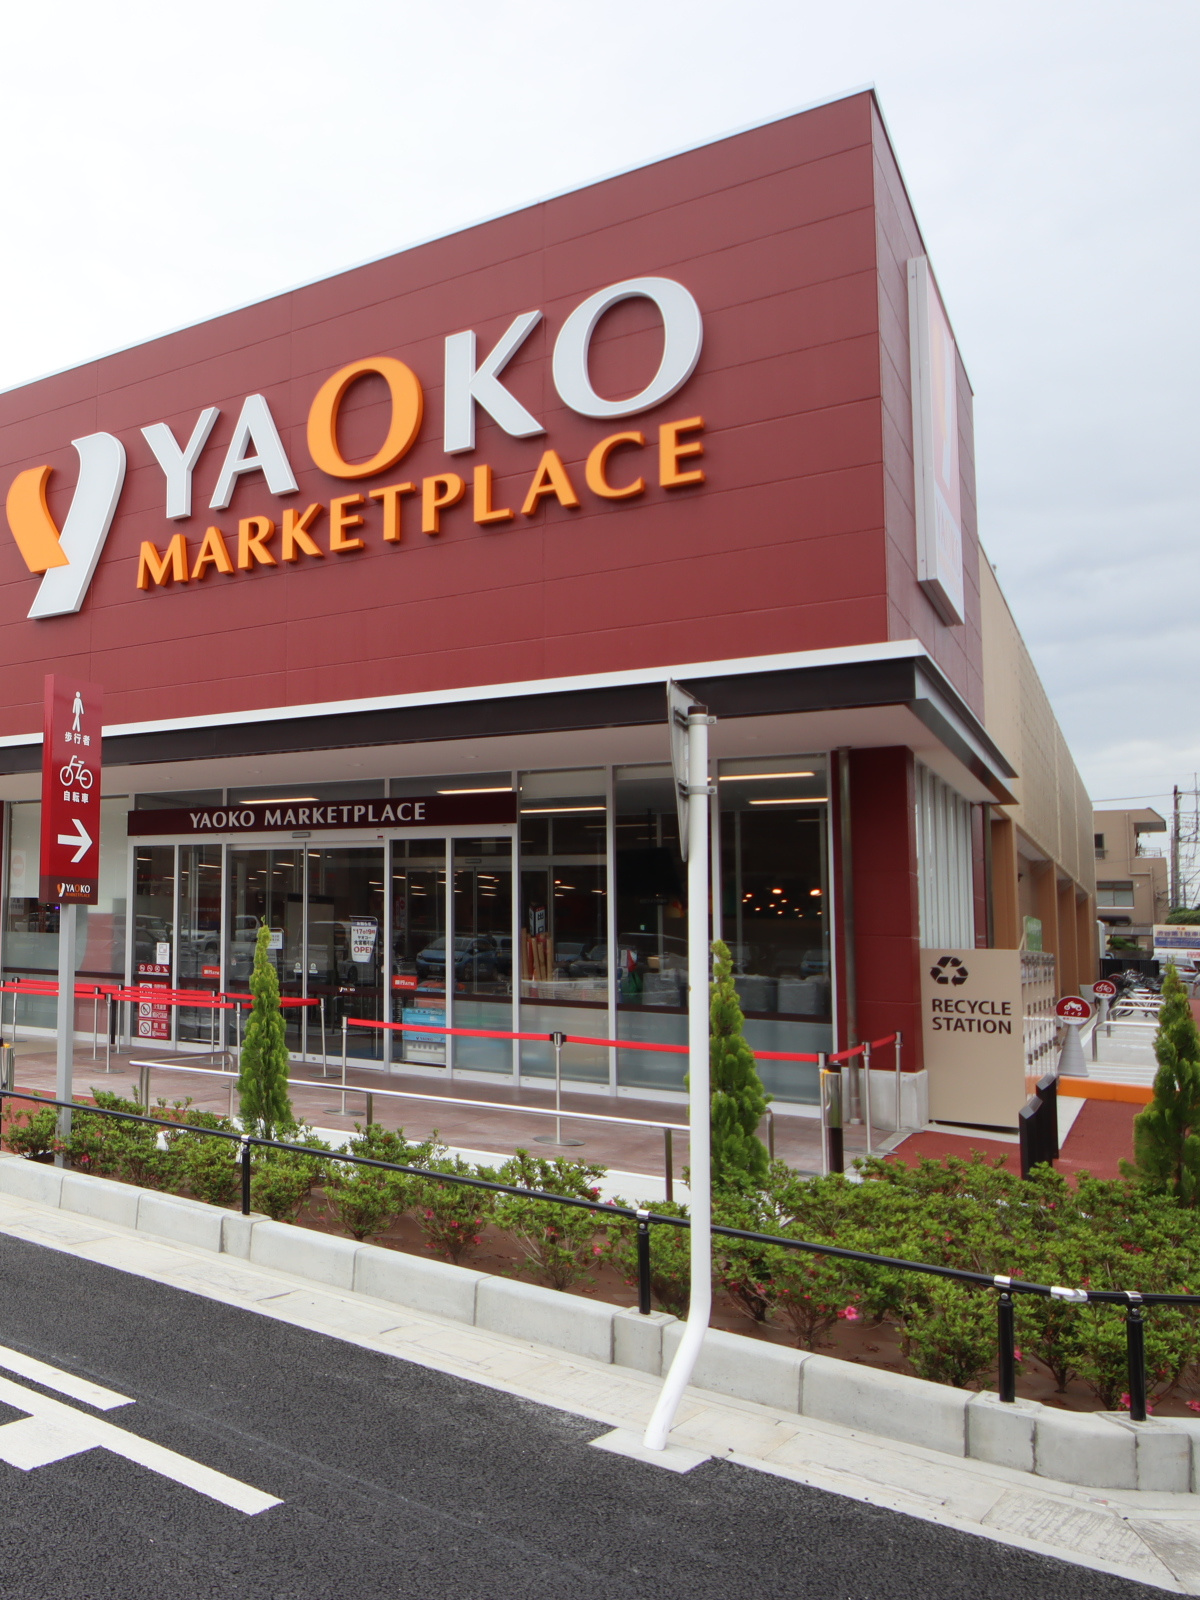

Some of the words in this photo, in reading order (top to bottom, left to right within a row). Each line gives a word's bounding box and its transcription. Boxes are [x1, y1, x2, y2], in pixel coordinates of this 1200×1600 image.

[140, 276, 704, 520] YAOKO
[136, 416, 705, 592] MARKETPLACE
[64, 731, 91, 747] 歩行者
[63, 790, 90, 804] 自転車
[190, 810, 255, 829] YAOKO
[264, 802, 426, 826] MARKETPLACE
[65, 884, 91, 894] YAOKO
[931, 998, 1012, 1016] RECYCLE
[932, 1016, 1012, 1034] STATION
